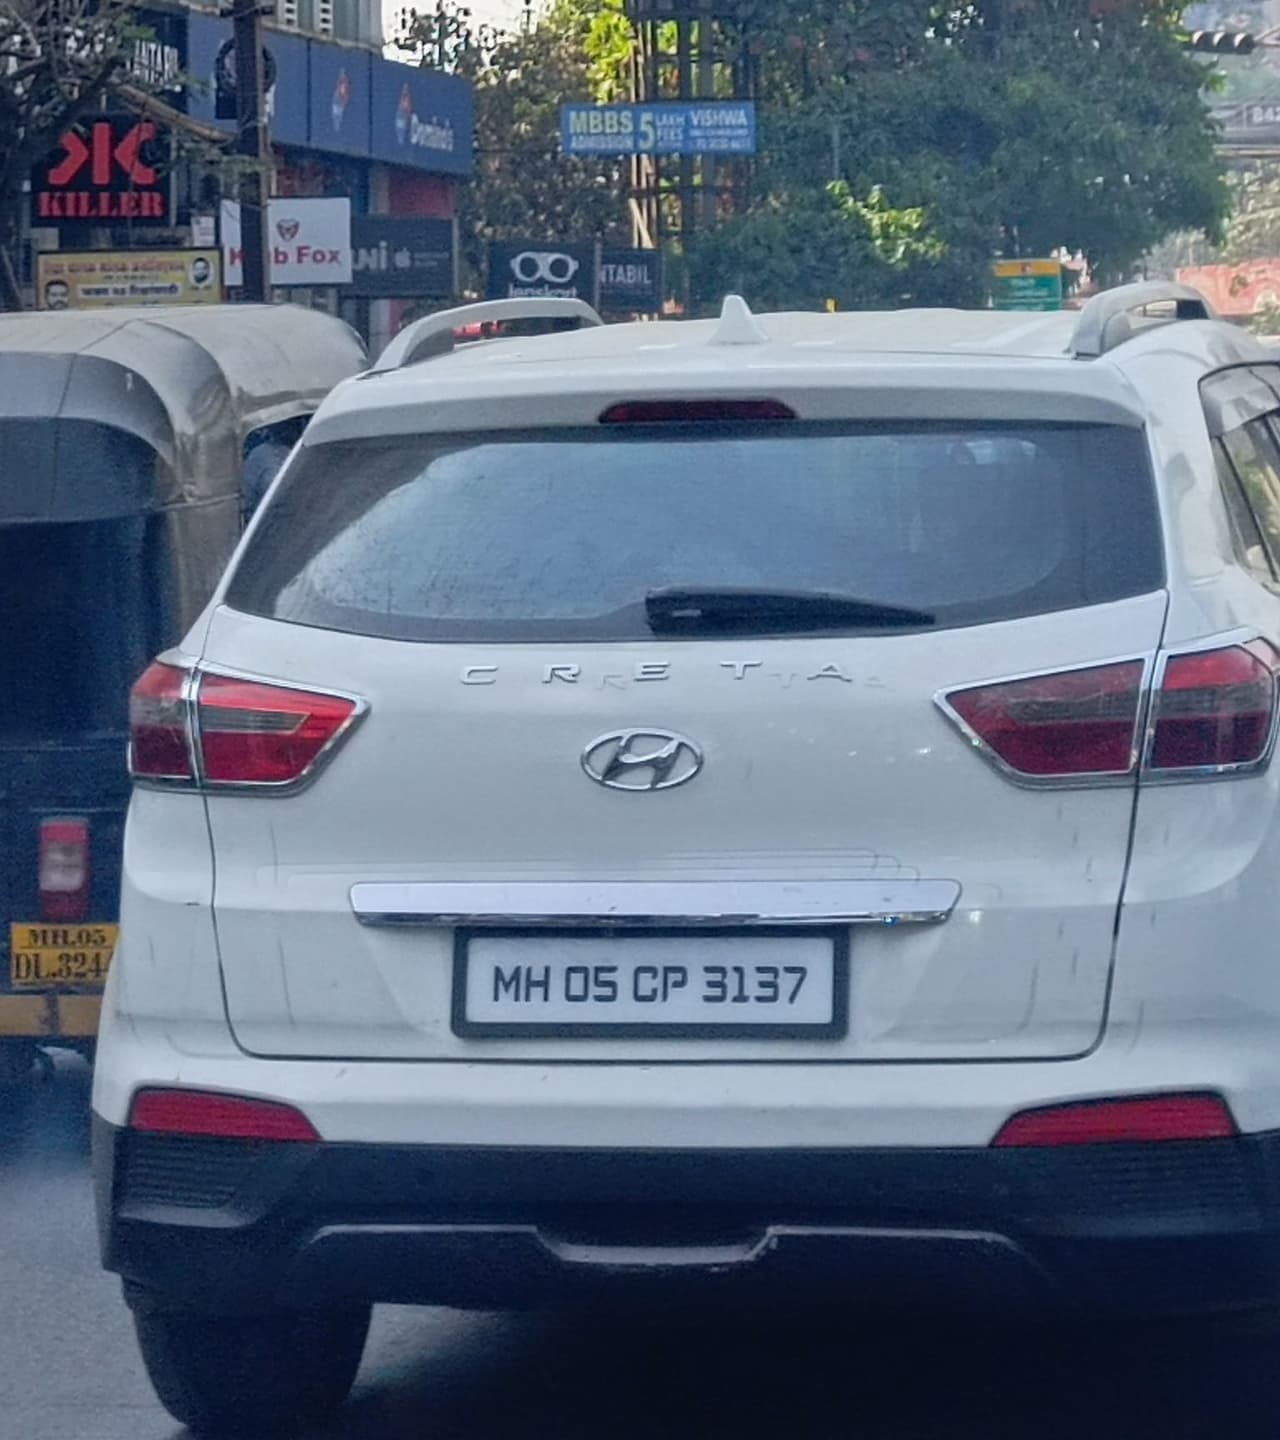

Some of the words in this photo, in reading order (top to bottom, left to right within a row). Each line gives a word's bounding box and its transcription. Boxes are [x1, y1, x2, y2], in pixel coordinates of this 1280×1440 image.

[569, 110, 634, 134] MBBS
[639, 112, 656, 151] 5
[690, 108, 749, 127] VISHWA
[38, 190, 164, 218] KILLER
[295, 245, 342, 266] Fox
[460, 660, 853, 684] CRETA
[13, 951, 113, 981] DL.324
[493, 965, 551, 1003] MH
[564, 965, 619, 1003] 05
[633, 965, 689, 1003] CP
[702, 965, 808, 1004] 3137
